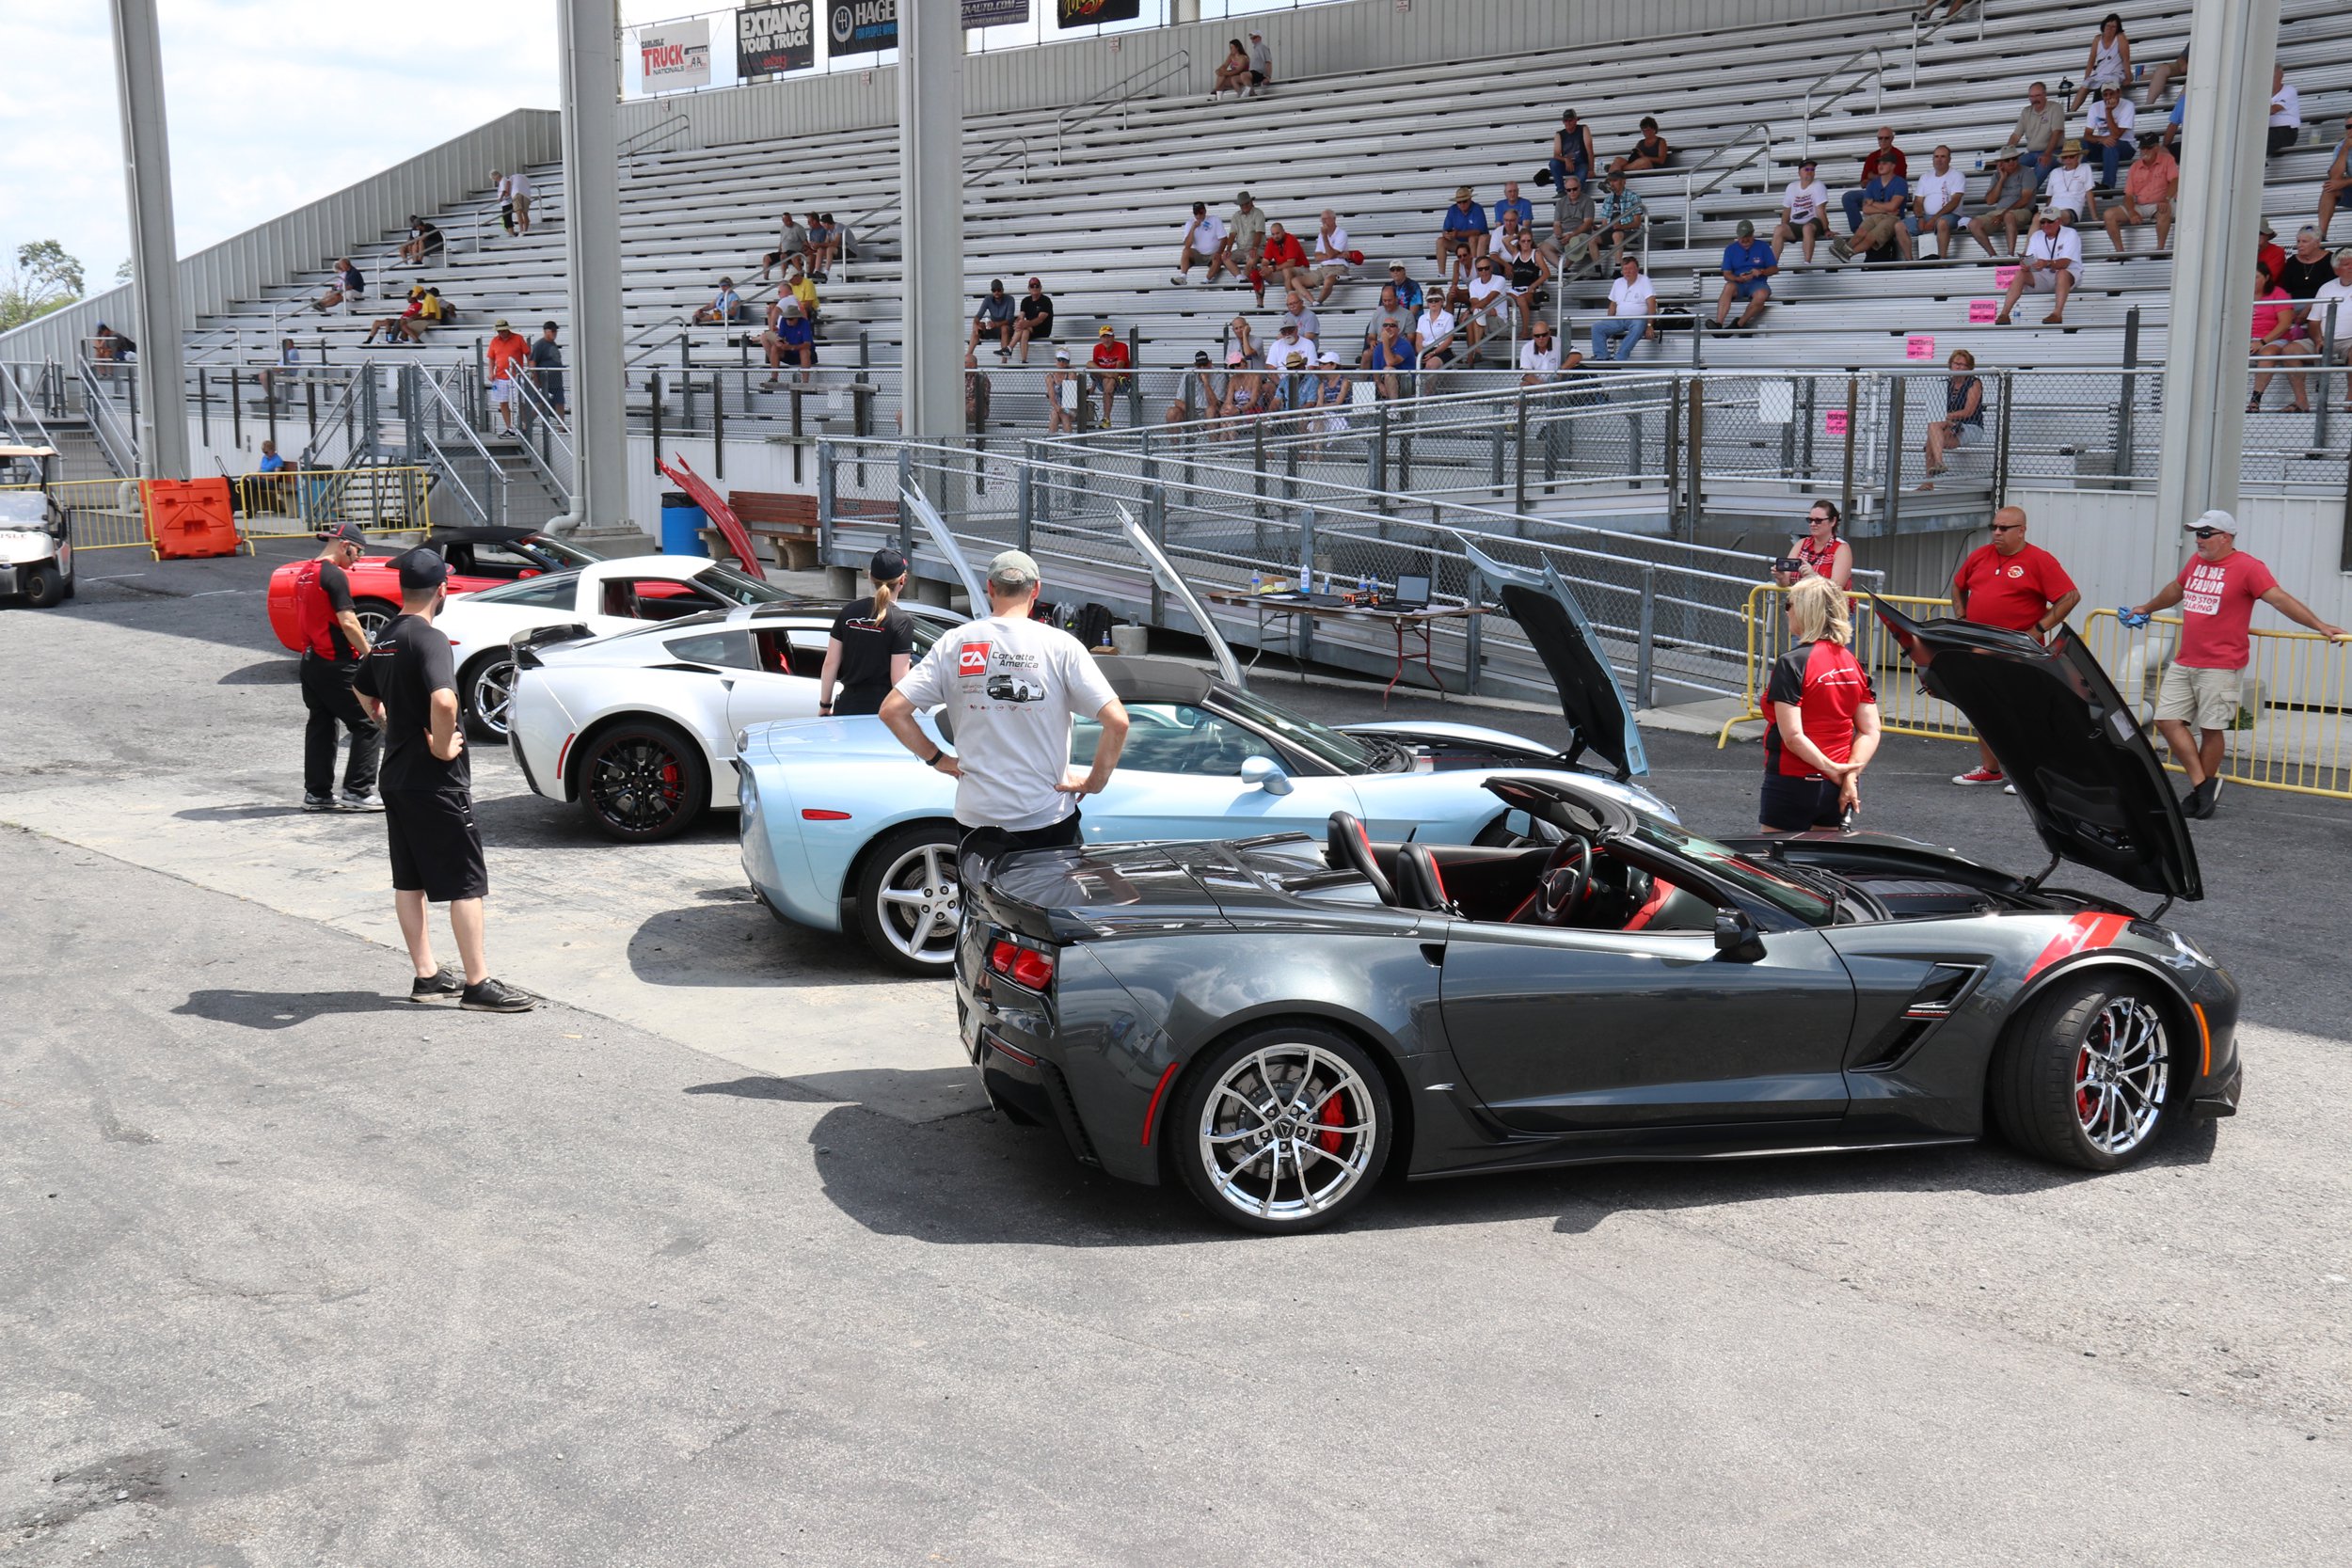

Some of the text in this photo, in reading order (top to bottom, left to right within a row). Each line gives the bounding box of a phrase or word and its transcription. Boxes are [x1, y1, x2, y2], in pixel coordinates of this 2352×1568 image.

[740, 4, 810, 39] EXTANG
[642, 39, 664, 48] CARLISLE
[741, 30, 809, 54] YOUR TRUCK
[642, 44, 684, 76] TRUCK
[654, 66, 685, 75] NATIONALS
[2207, 567, 2225, 580] ME
[2190, 578, 2224, 594] FAVOR
[2198, 596, 2218, 605] STOP
[960, 650, 987, 667] CA
[992, 651, 1035, 661] Corvette
[999, 659, 1040, 669] America
